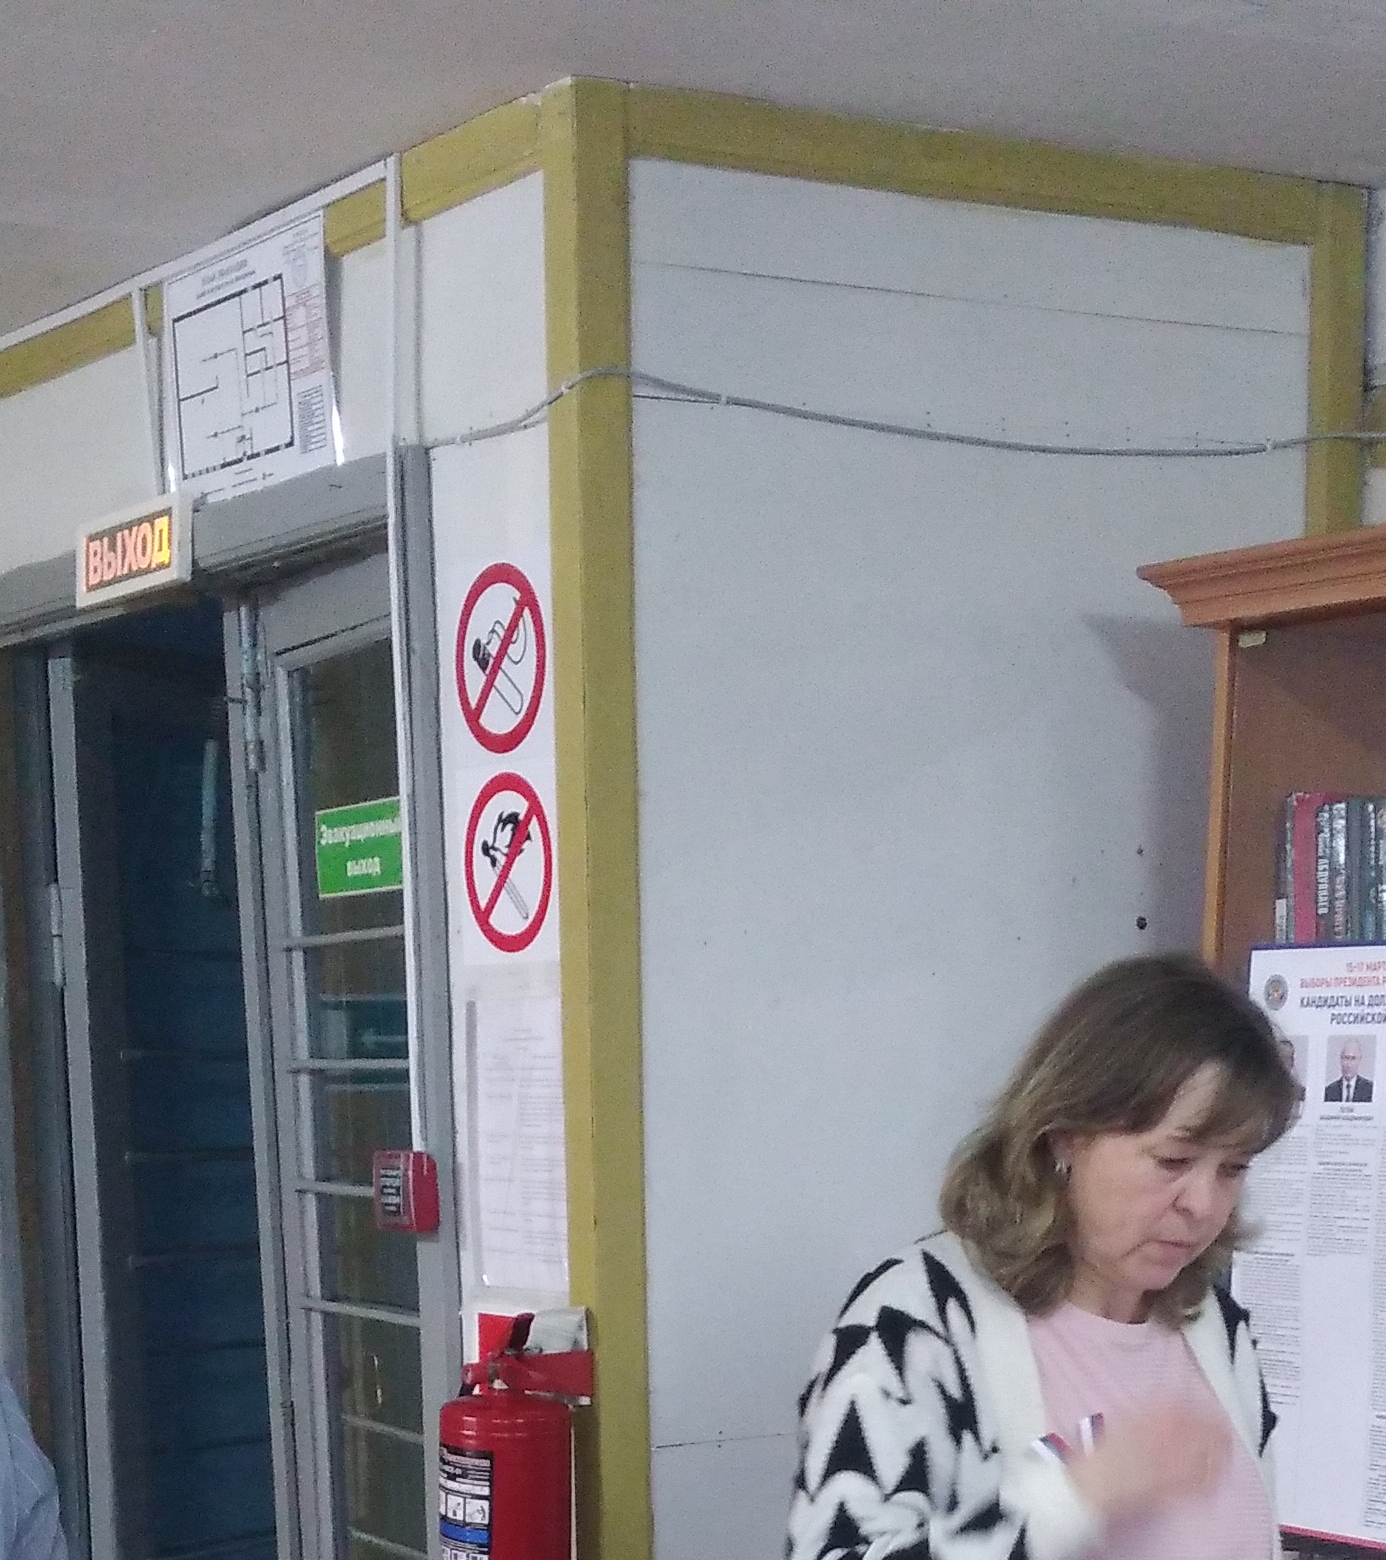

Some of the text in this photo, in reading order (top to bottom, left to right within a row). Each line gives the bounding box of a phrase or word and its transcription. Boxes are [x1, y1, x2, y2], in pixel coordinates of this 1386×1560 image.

[88, 515, 171, 586] ВЫХОД
[347, 857, 380, 876] выход
[1299, 995, 1352, 1009] КАНДИДАТЫ
[1353, 995, 1365, 1007] НА
